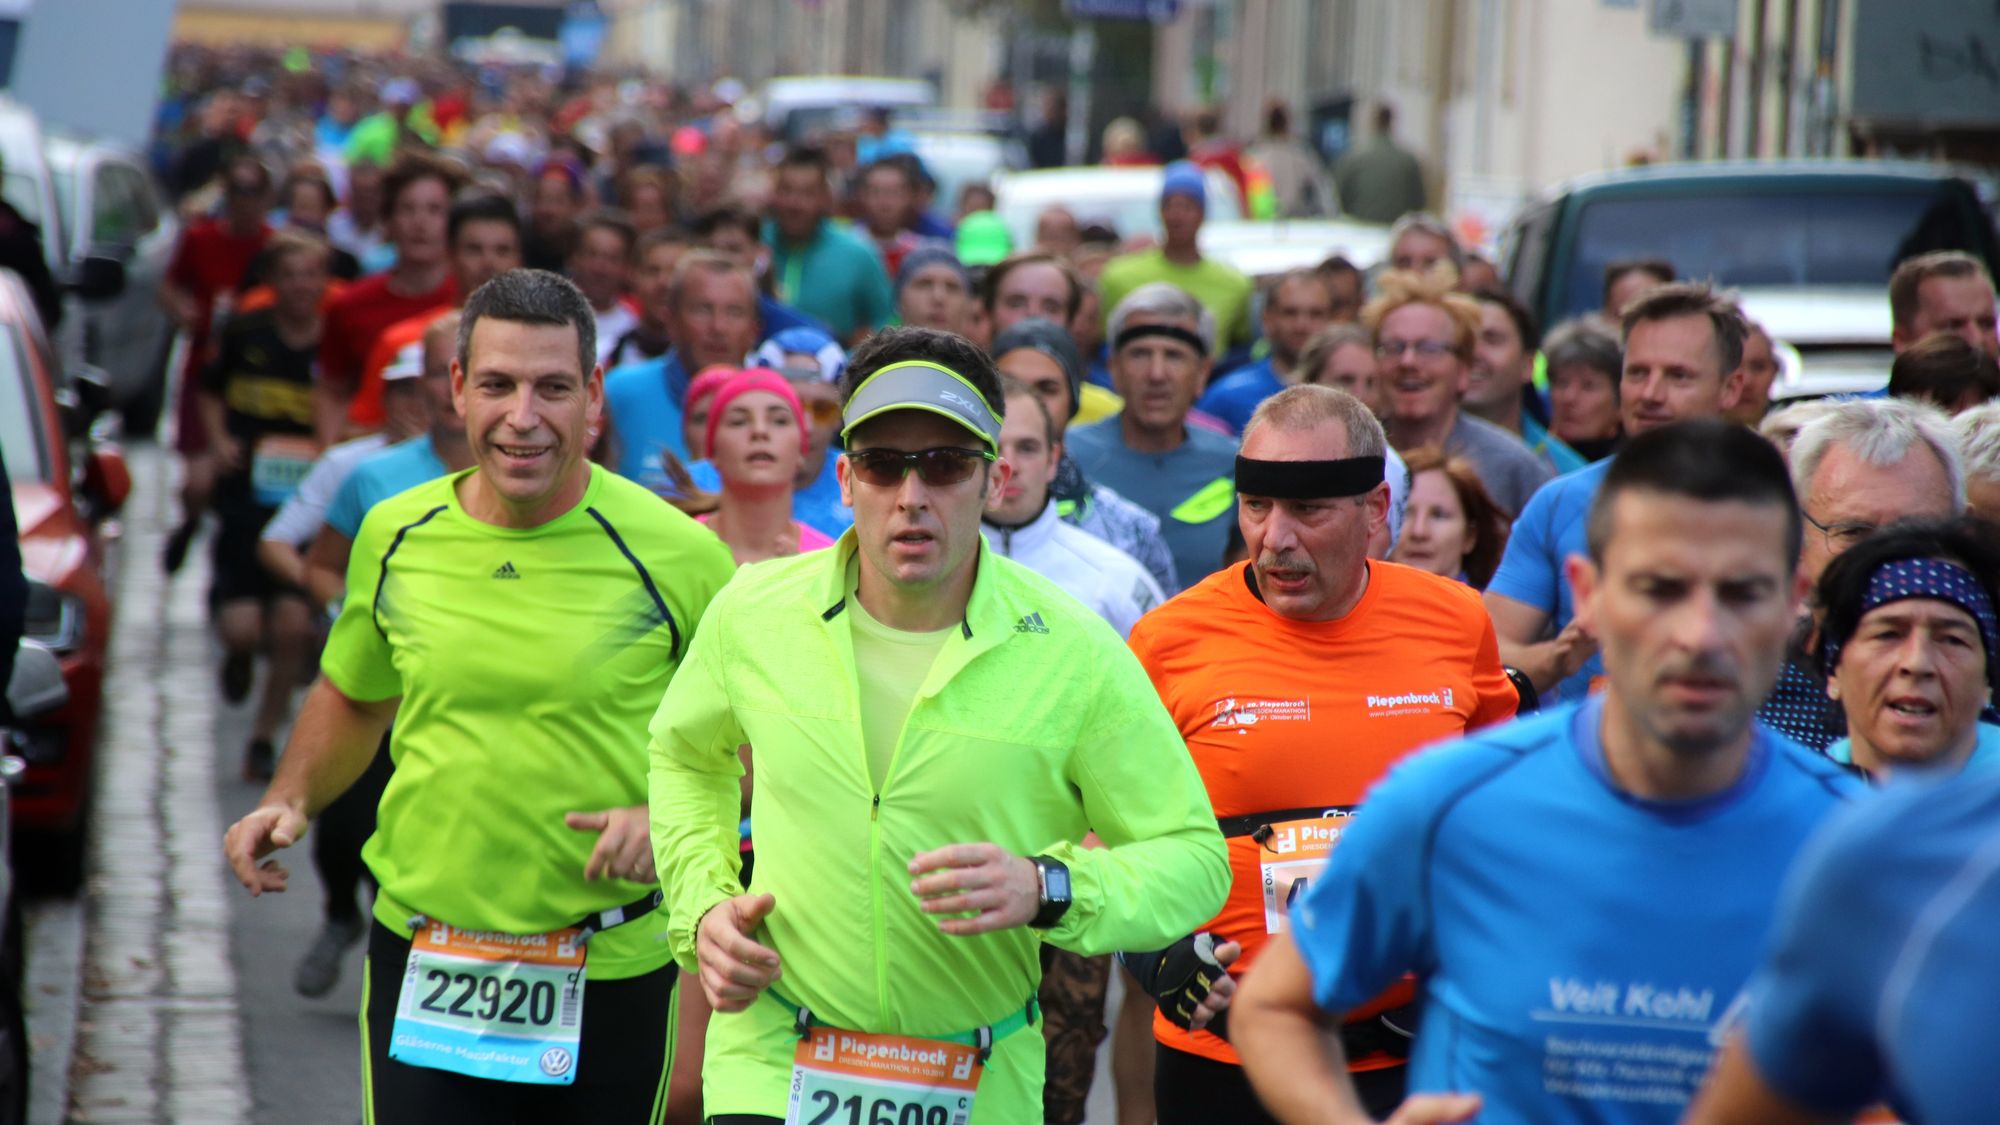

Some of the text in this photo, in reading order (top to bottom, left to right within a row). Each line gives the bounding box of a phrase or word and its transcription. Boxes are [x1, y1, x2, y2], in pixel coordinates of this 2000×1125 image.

[1260, 700, 1305, 708] Piepenbrock
[1367, 692, 1440, 708] Piepenbrock
[1301, 825, 1343, 842] Piep
[420, 969, 556, 1026] 22920
[1549, 979, 1714, 1022] Veit Kohl
[841, 1036, 947, 1066] Piepenbrock
[958, 1097, 967, 1109] C
